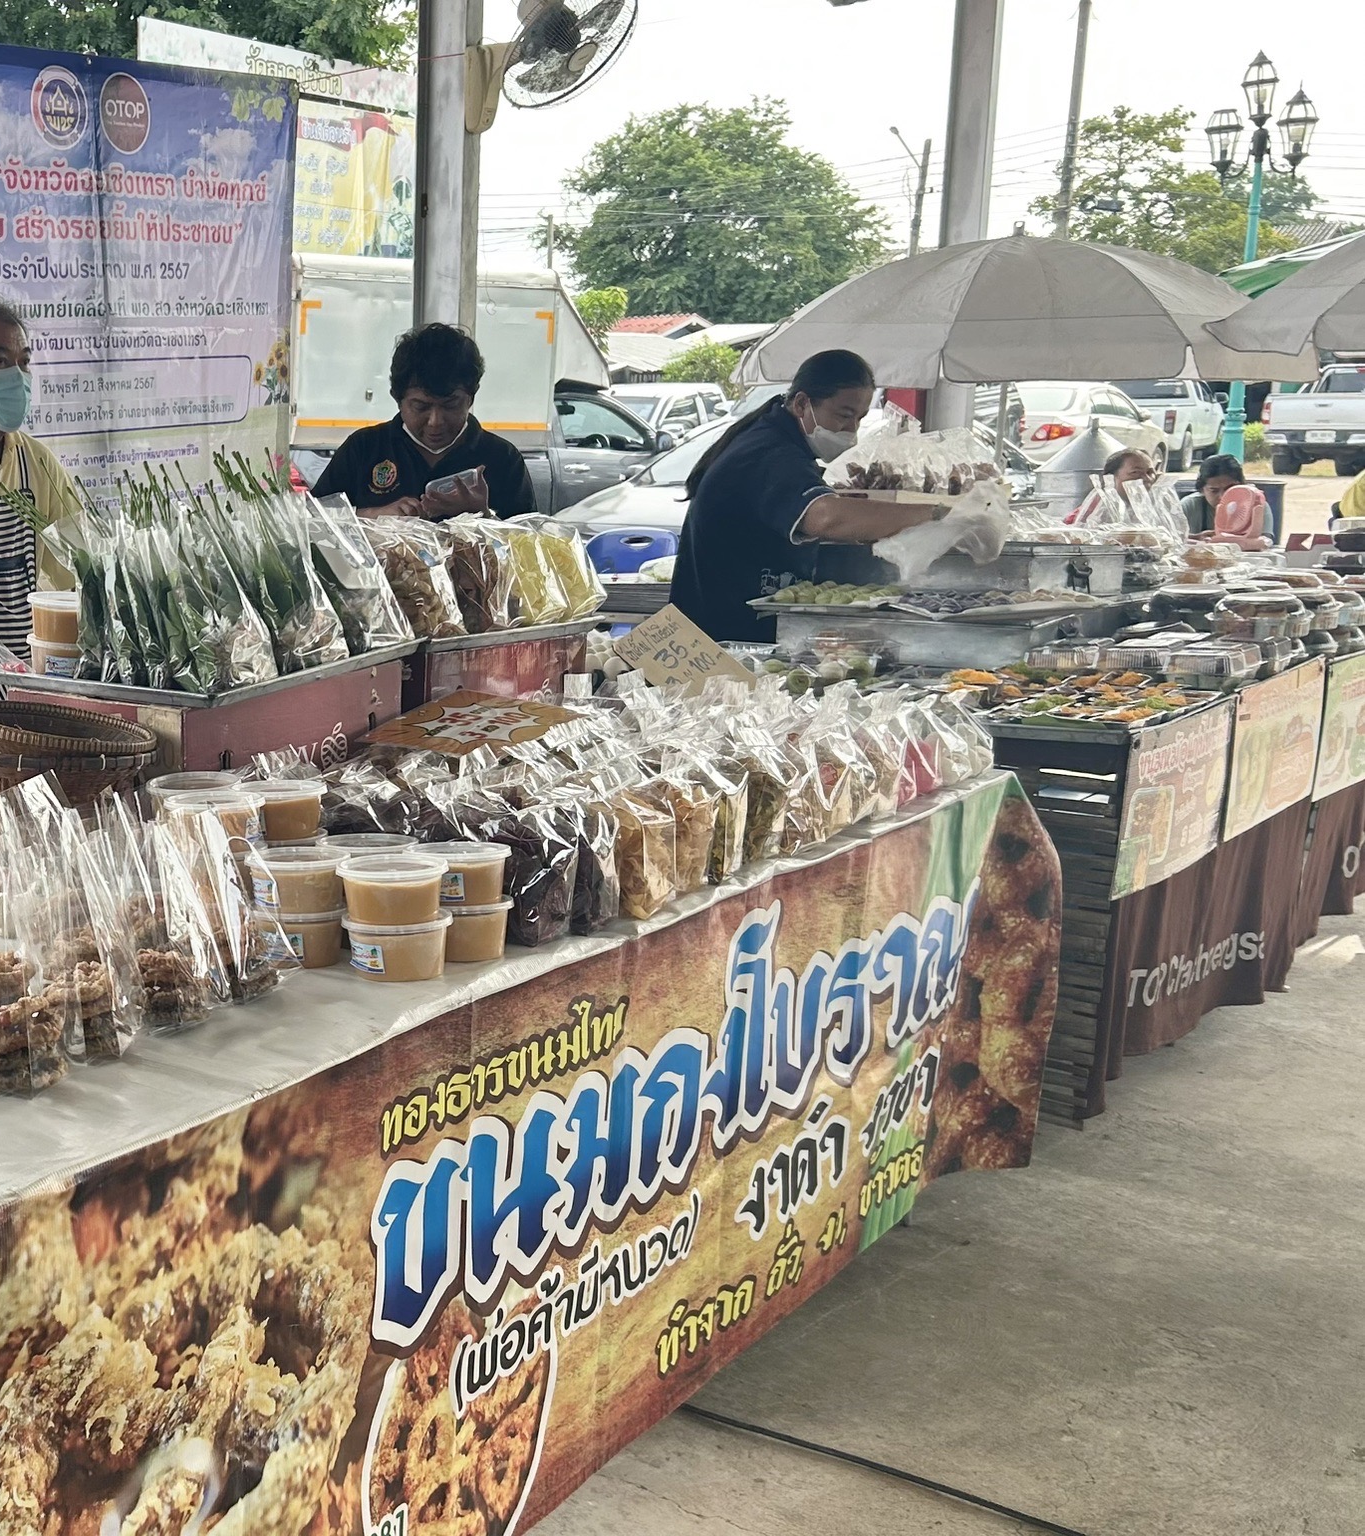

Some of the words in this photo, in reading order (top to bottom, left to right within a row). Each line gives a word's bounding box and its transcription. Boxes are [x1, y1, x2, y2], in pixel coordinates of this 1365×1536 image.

[104, 98, 145, 119] OTOP
[182, 169, 267, 210] บำบัดทุกข์
[130, 262, 156, 280] พ.ศ.
[159, 262, 190, 280] 2567
[41, 375, 80, 398] วันพุธที่
[82, 379, 95, 393] 21
[97, 377, 132, 394] สิงหาคม
[134, 376, 155, 390] 2567
[45, 410, 53, 424] 6
[56, 405, 114, 424] ตำบลหัวไทร
[653, 640, 688, 670] 35
[375, 882, 980, 1330] ขนมกงโบราณ
[739, 1100, 846, 1233] งาดำ
[454, 1193, 700, 1409] (พ่อค้ามีหนวด)
[657, 1278, 757, 1375] ทำจาก
